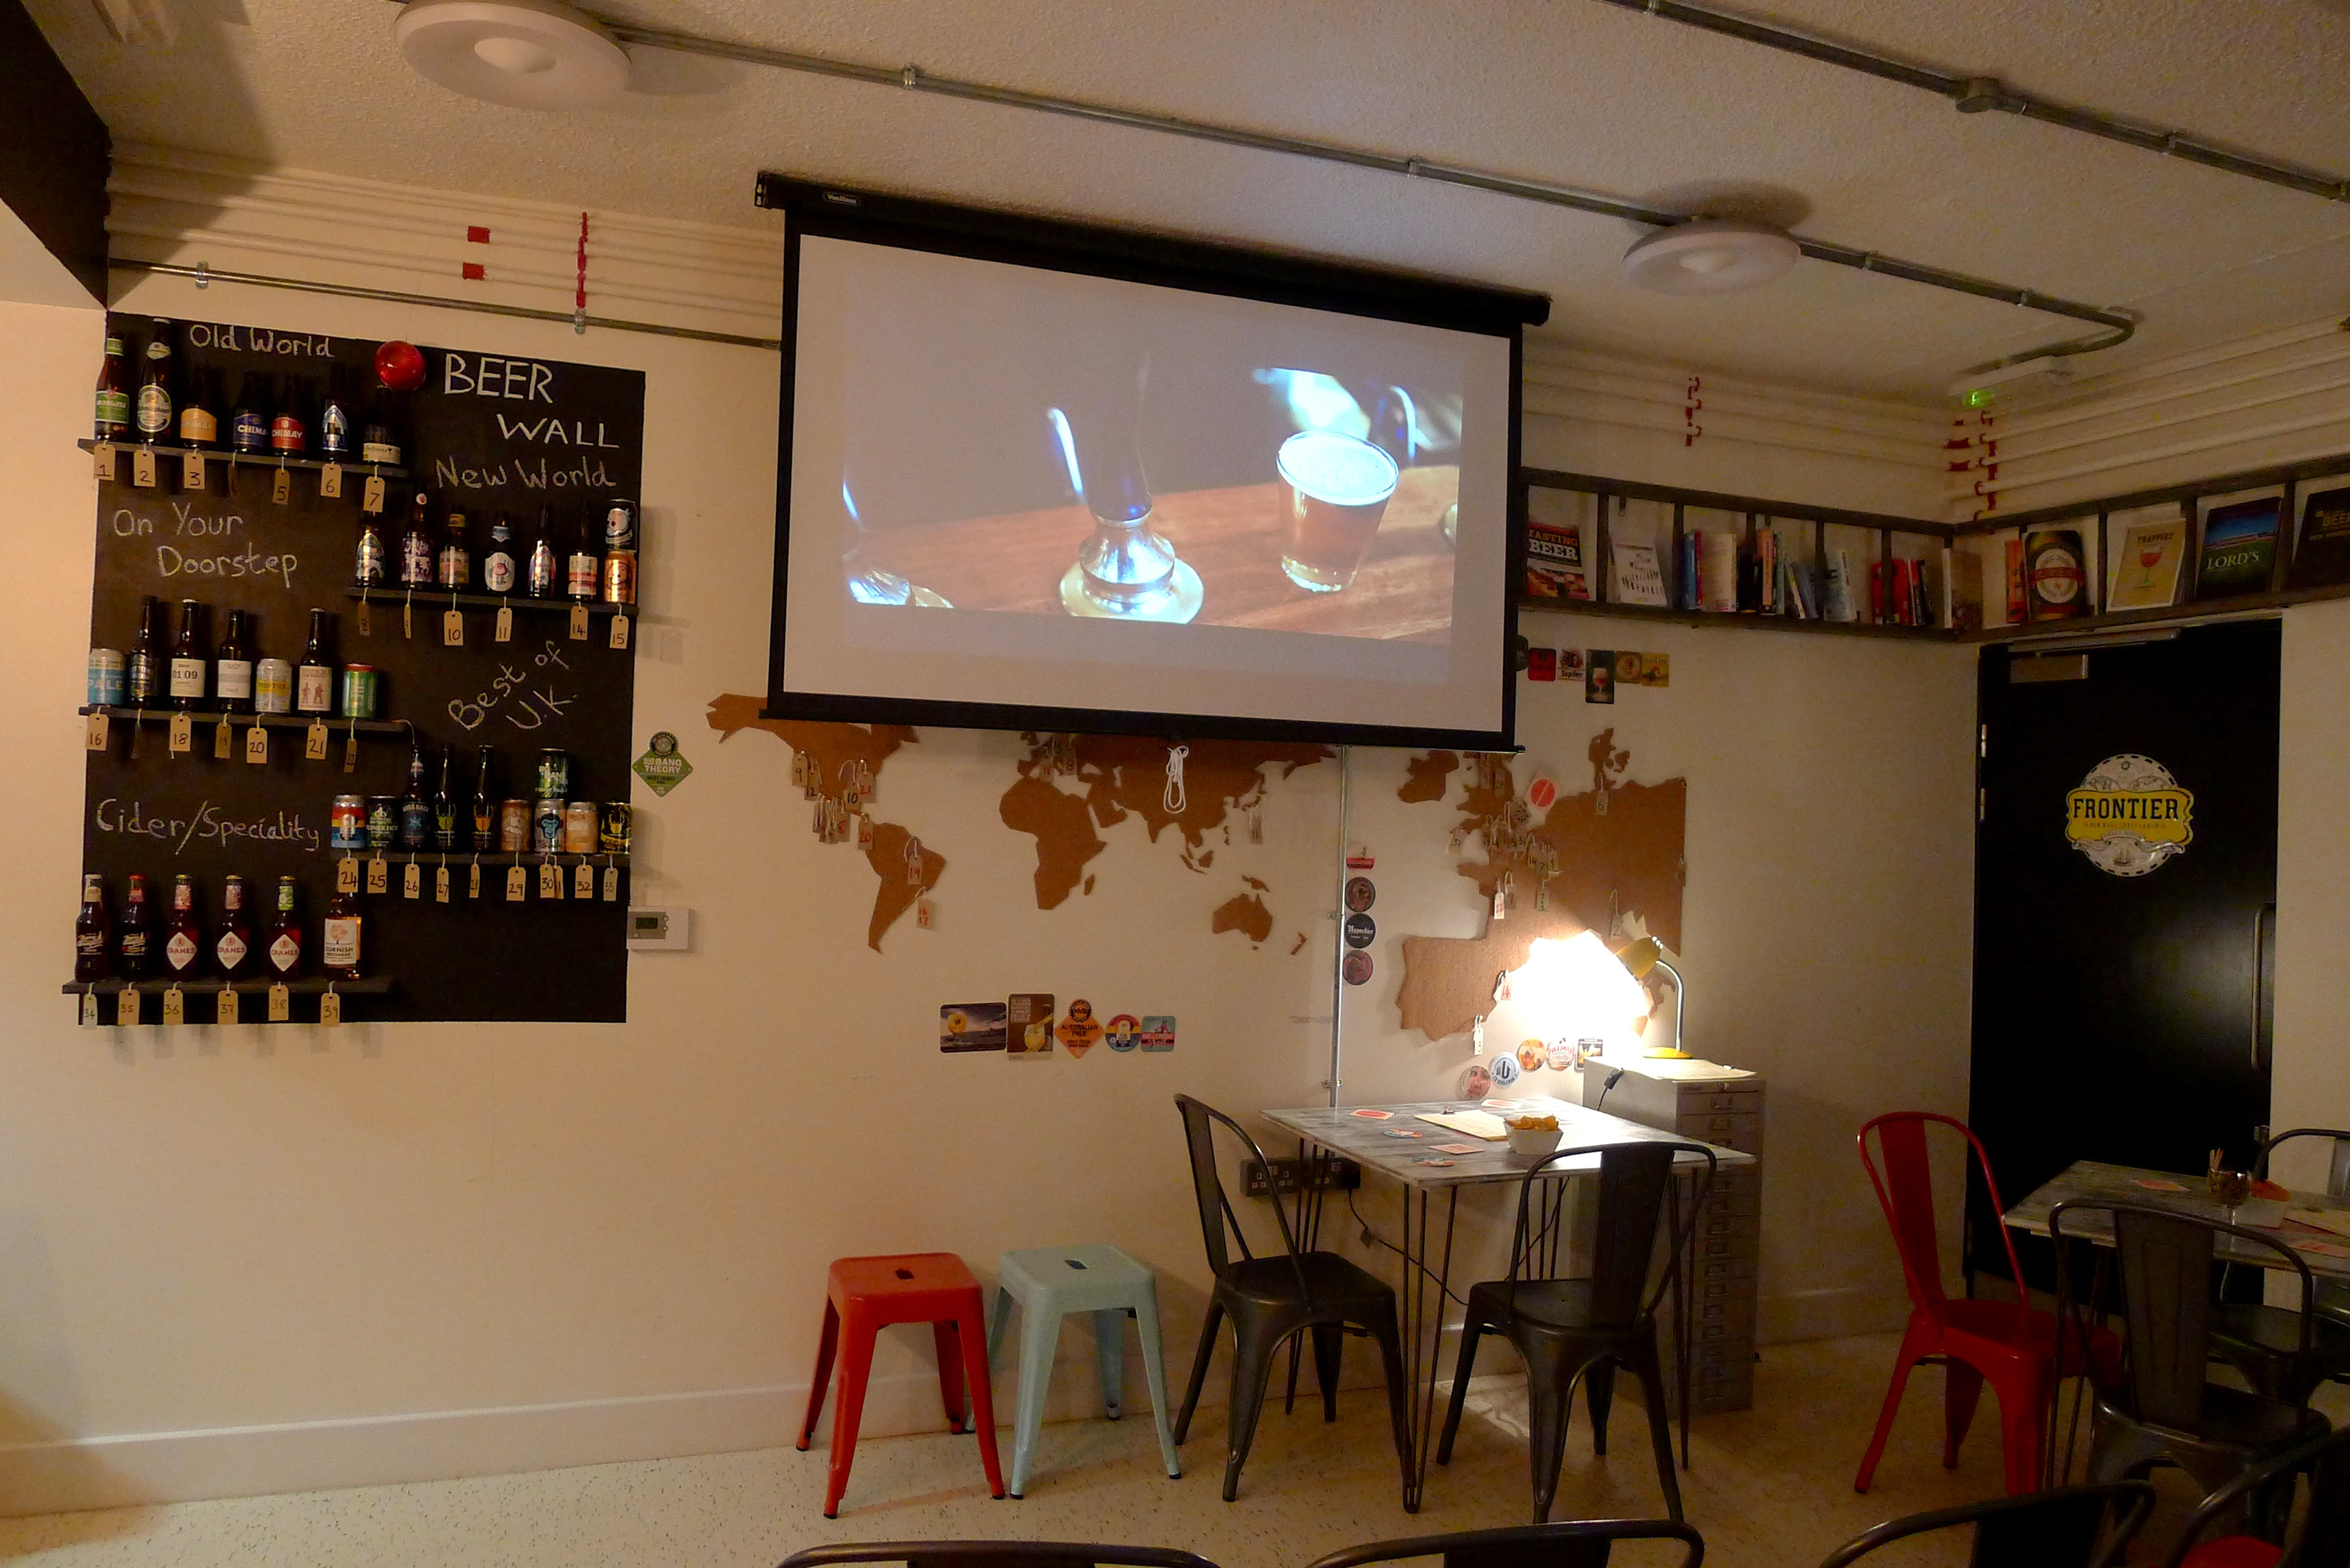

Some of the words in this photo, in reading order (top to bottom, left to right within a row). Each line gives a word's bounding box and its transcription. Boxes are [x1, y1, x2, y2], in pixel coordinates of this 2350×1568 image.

[189, 324, 241, 352] Old
[250, 325, 335, 358] World
[444, 353, 554, 404] BEER
[237, 424, 268, 435] CHIMA
[272, 429, 303, 439] CHIMAY
[496, 413, 621, 449] WALL
[96, 464, 111, 477] 1
[139, 470, 152, 483] 2
[435, 454, 508, 489] New
[515, 455, 617, 490] World
[190, 471, 201, 486] 3
[325, 479, 334, 493] 6
[278, 485, 288, 501] 5
[370, 492, 380, 506] 7
[113, 509, 154, 537] On
[172, 502, 245, 537] Your
[1529, 530, 1578, 546] TASTING
[1529, 538, 1578, 561] BEER
[157, 541, 298, 589] Doorstep
[2207, 550, 2261, 570] LORD'S
[448, 628, 461, 641] 10
[499, 627, 507, 639] 11
[572, 623, 587, 637] 14
[612, 633, 625, 645] 15
[172, 670, 181, 679] 01
[184, 670, 198, 679] 09
[447, 663, 527, 731] Best
[535, 639, 571, 671] of
[90, 733, 103, 746] 16
[173, 732, 189, 745] 18
[249, 741, 265, 754] 20
[309, 738, 324, 755] 21
[644, 765, 681, 773] THEORY
[655, 758, 682, 767] BANG
[1065, 759, 1074, 771] 8
[795, 768, 803, 782] 9
[807, 786, 817, 796] 12
[847, 792, 858, 804] 10
[2073, 798, 2179, 820] FRONTIER
[96, 798, 321, 857] Cider/Speciality
[341, 871, 357, 887] 24
[370, 874, 386, 888] 25
[541, 877, 553, 890] 30
[406, 880, 418, 892] 26
[438, 884, 449, 897] 27
[508, 883, 523, 897] 29
[576, 880, 592, 892] 32
[1502, 984, 1510, 999] 14
[120, 1004, 134, 1013] 35
[164, 1004, 180, 1015] 36
[220, 1004, 233, 1015] 37
[271, 999, 286, 1010] 38
[323, 1005, 339, 1019] 39
